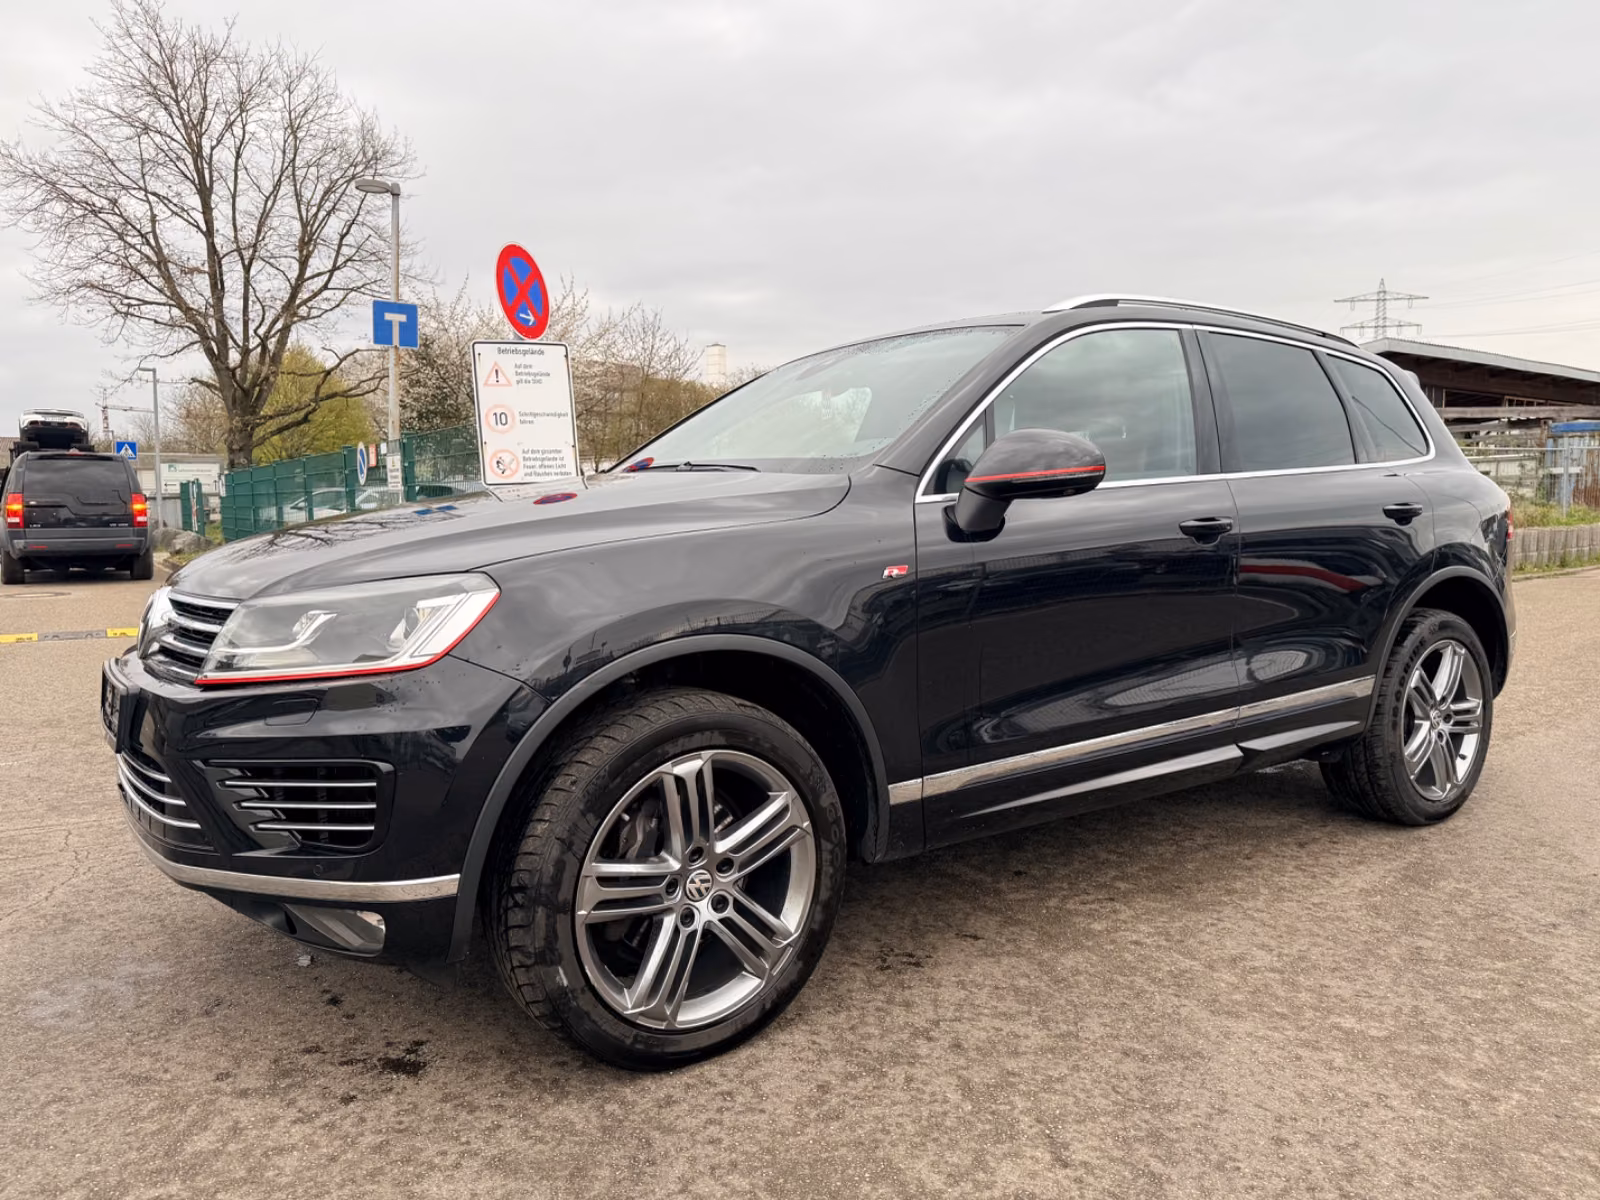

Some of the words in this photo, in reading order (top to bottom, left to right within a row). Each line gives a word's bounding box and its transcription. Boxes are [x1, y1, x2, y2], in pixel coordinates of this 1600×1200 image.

[497, 347, 545, 356] Betriebsgelände
[492, 411, 508, 426] 10
[686, 868, 712, 902] VW
